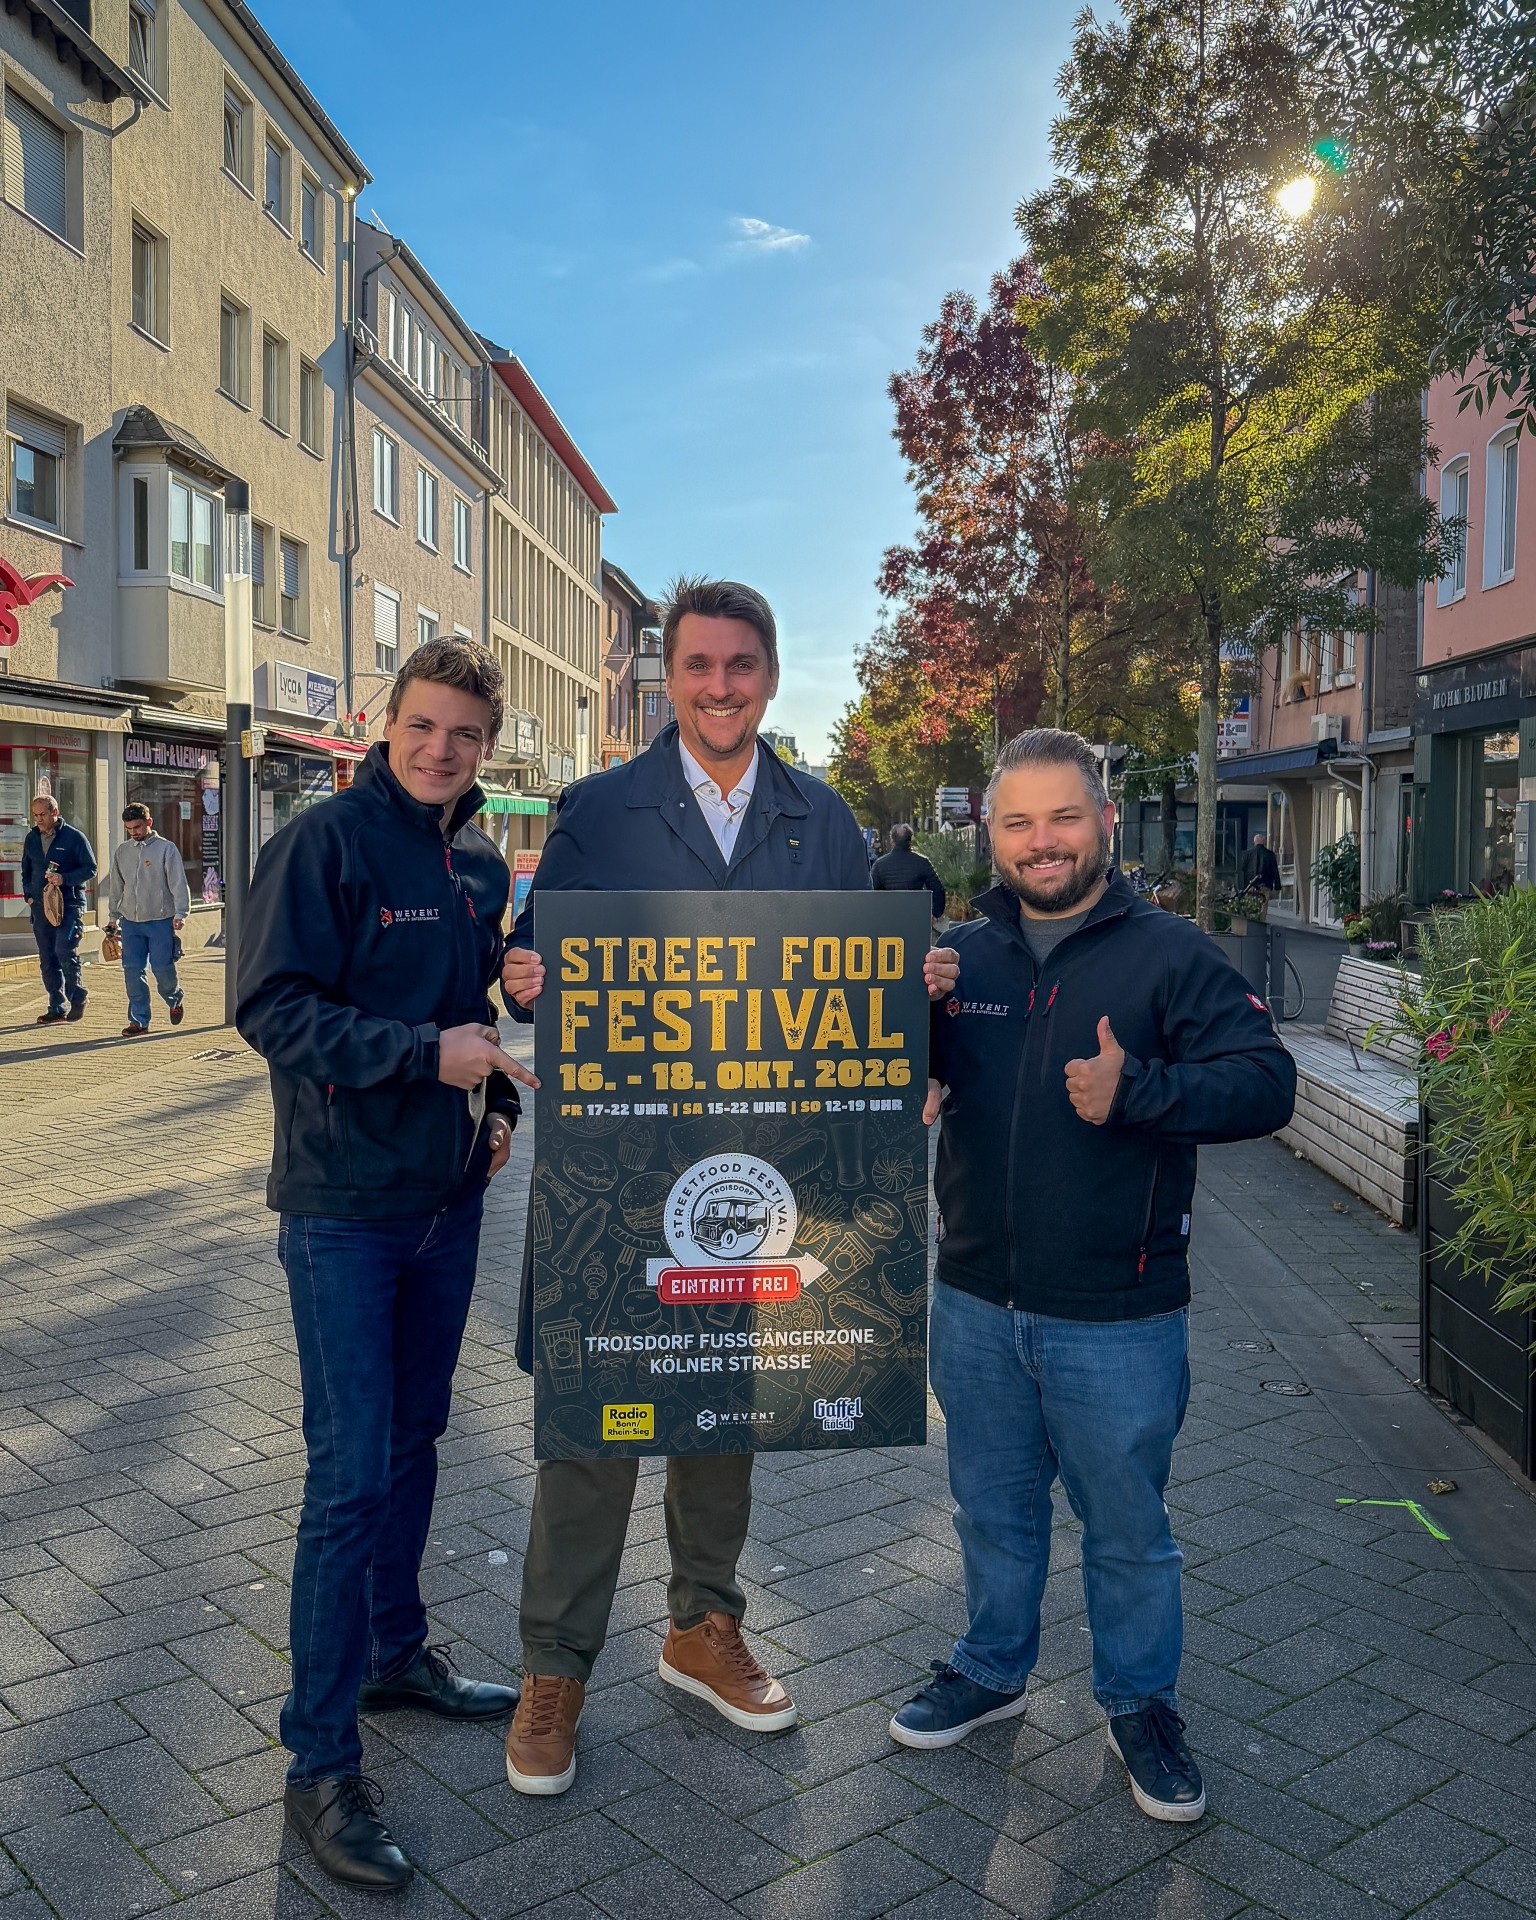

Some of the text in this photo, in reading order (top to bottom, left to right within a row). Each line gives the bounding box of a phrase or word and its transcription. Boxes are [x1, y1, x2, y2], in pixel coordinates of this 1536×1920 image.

[279, 672, 297, 696] Lyca
[1433, 678, 1508, 710] MOHN BLUMEN
[47, 732, 82, 748] Immobilien
[126, 739, 152, 764] GOLD
[394, 908, 439, 918] WEVENT
[561, 936, 905, 982] STREET FOOD
[962, 1001, 1009, 1012] WEVENT
[560, 987, 904, 1052] FESTIVAL
[559, 1062, 617, 1091] 16.
[652, 1061, 707, 1090] 18.
[716, 1060, 806, 1090] OKT.
[815, 1058, 911, 1088] 2026
[561, 1104, 583, 1117] FR
[586, 1103, 630, 1116] 17-22
[633, 1102, 668, 1116] UHR
[682, 1102, 703, 1115] SA
[707, 1102, 749, 1115] 15-22
[752, 1101, 787, 1114] UHR
[800, 1100, 821, 1113] SO
[825, 1099, 866, 1112] 12-19
[869, 1098, 903, 1112] UHR
[709, 1183, 755, 1198] TROISDORF
[673, 1163, 789, 1239] STREETFOOD FESTIVAL
[671, 1276, 788, 1295] EINTRITT FREI
[585, 1328, 875, 1352] TROISDORF FUSSGÄNGERZONE
[650, 1353, 812, 1374] KÖLNER STRASSE
[609, 1408, 648, 1420] Radio
[720, 1411, 775, 1421] WEVENT
[814, 1397, 863, 1420] Gaffel
[607, 1428, 650, 1437] Rhein-Sieg
[616, 1420, 640, 1428] Bonn/
